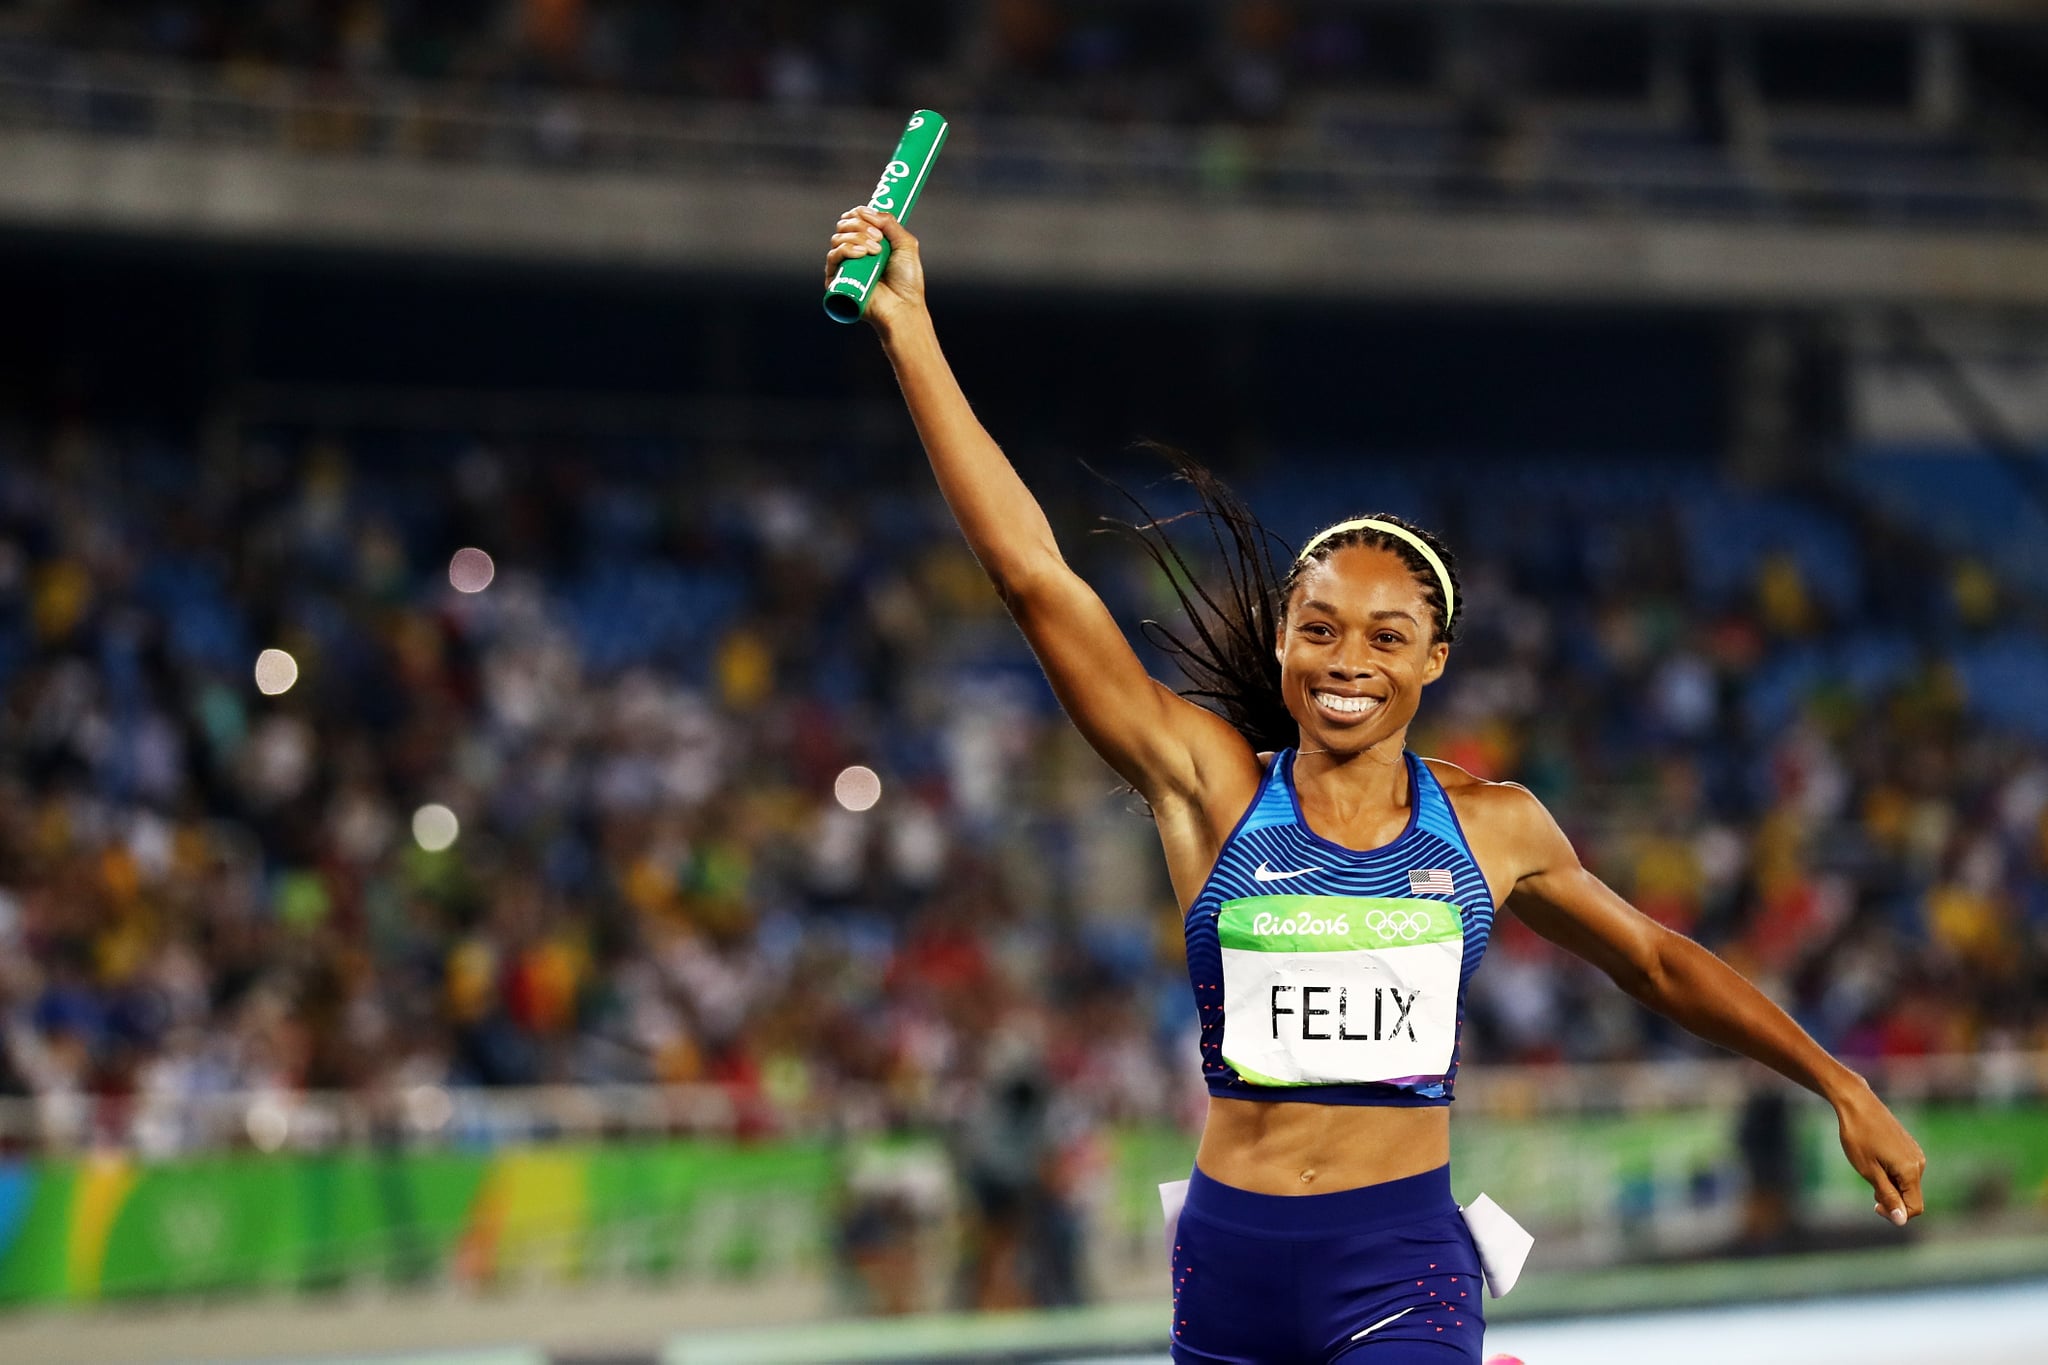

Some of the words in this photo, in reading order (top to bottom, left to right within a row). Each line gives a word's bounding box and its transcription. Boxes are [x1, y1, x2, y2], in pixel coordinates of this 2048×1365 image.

[866, 160, 910, 212] Rio2
[1253, 911, 1350, 936] Rio2016
[1271, 985, 1421, 1043] FELIX
